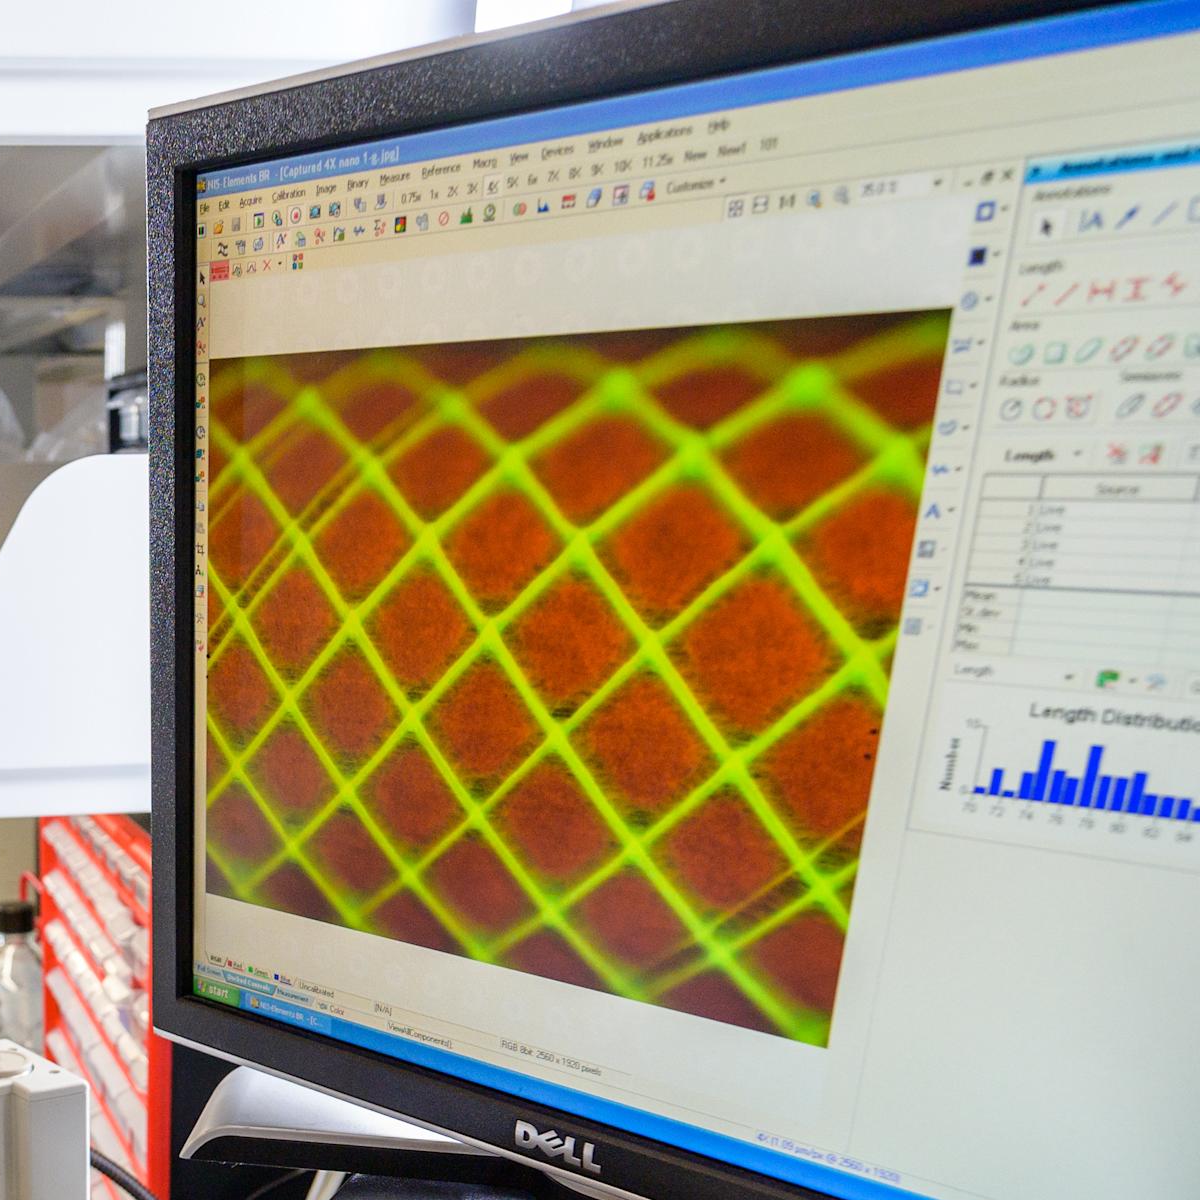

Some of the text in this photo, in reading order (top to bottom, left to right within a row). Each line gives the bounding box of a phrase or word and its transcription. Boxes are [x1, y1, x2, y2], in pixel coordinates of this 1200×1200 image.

[200, 203, 209, 215] File
[219, 200, 230, 212] Edit
[240, 197, 262, 208] Acquire
[272, 188, 306, 203] Calibration
[316, 184, 336, 197] Image
[347, 178, 369, 192] Binary
[380, 172, 410, 186] Measure
[422, 163, 461, 179] Reference
[473, 158, 498, 169] Macro
[510, 152, 529, 166] View
[588, 136, 623, 154] Window
[637, 125, 693, 146] Applications
[339, 156, 360, 169] nano
[1004, 449, 1055, 464] Length
[1029, 702, 1097, 725] Length
[208, 984, 229, 999] start
[299, 980, 334, 999] Uncalibrated
[501, 1039, 518, 1052] RGB
[515, 1119, 602, 1173] DELL
